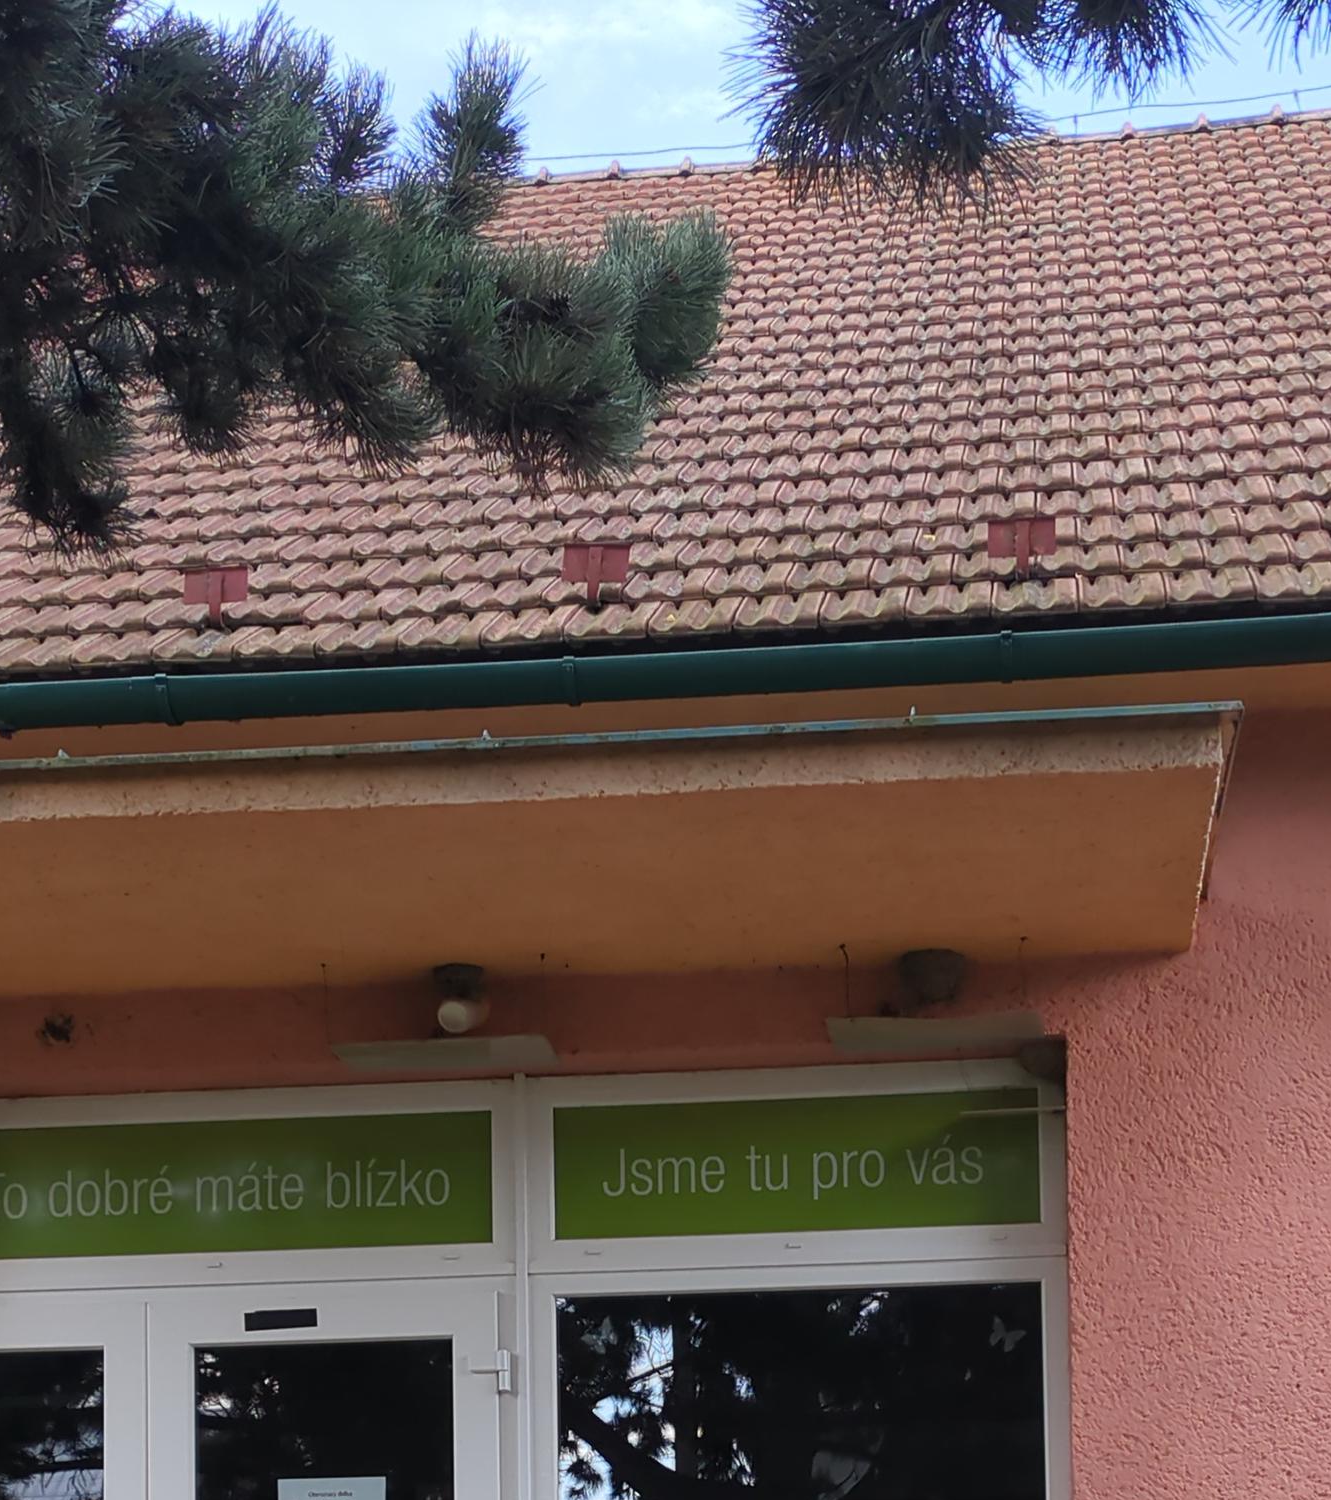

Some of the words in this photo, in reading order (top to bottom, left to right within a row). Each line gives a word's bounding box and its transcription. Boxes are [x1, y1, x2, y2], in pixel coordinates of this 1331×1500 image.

[48, 1164, 173, 1218] dobré
[195, 1161, 304, 1214] máte
[325, 1158, 450, 1209] blízko
[602, 1148, 725, 1197] Jsme
[745, 1145, 789, 1192] tu
[812, 1148, 886, 1200] pro
[906, 1134, 984, 1186] vás
